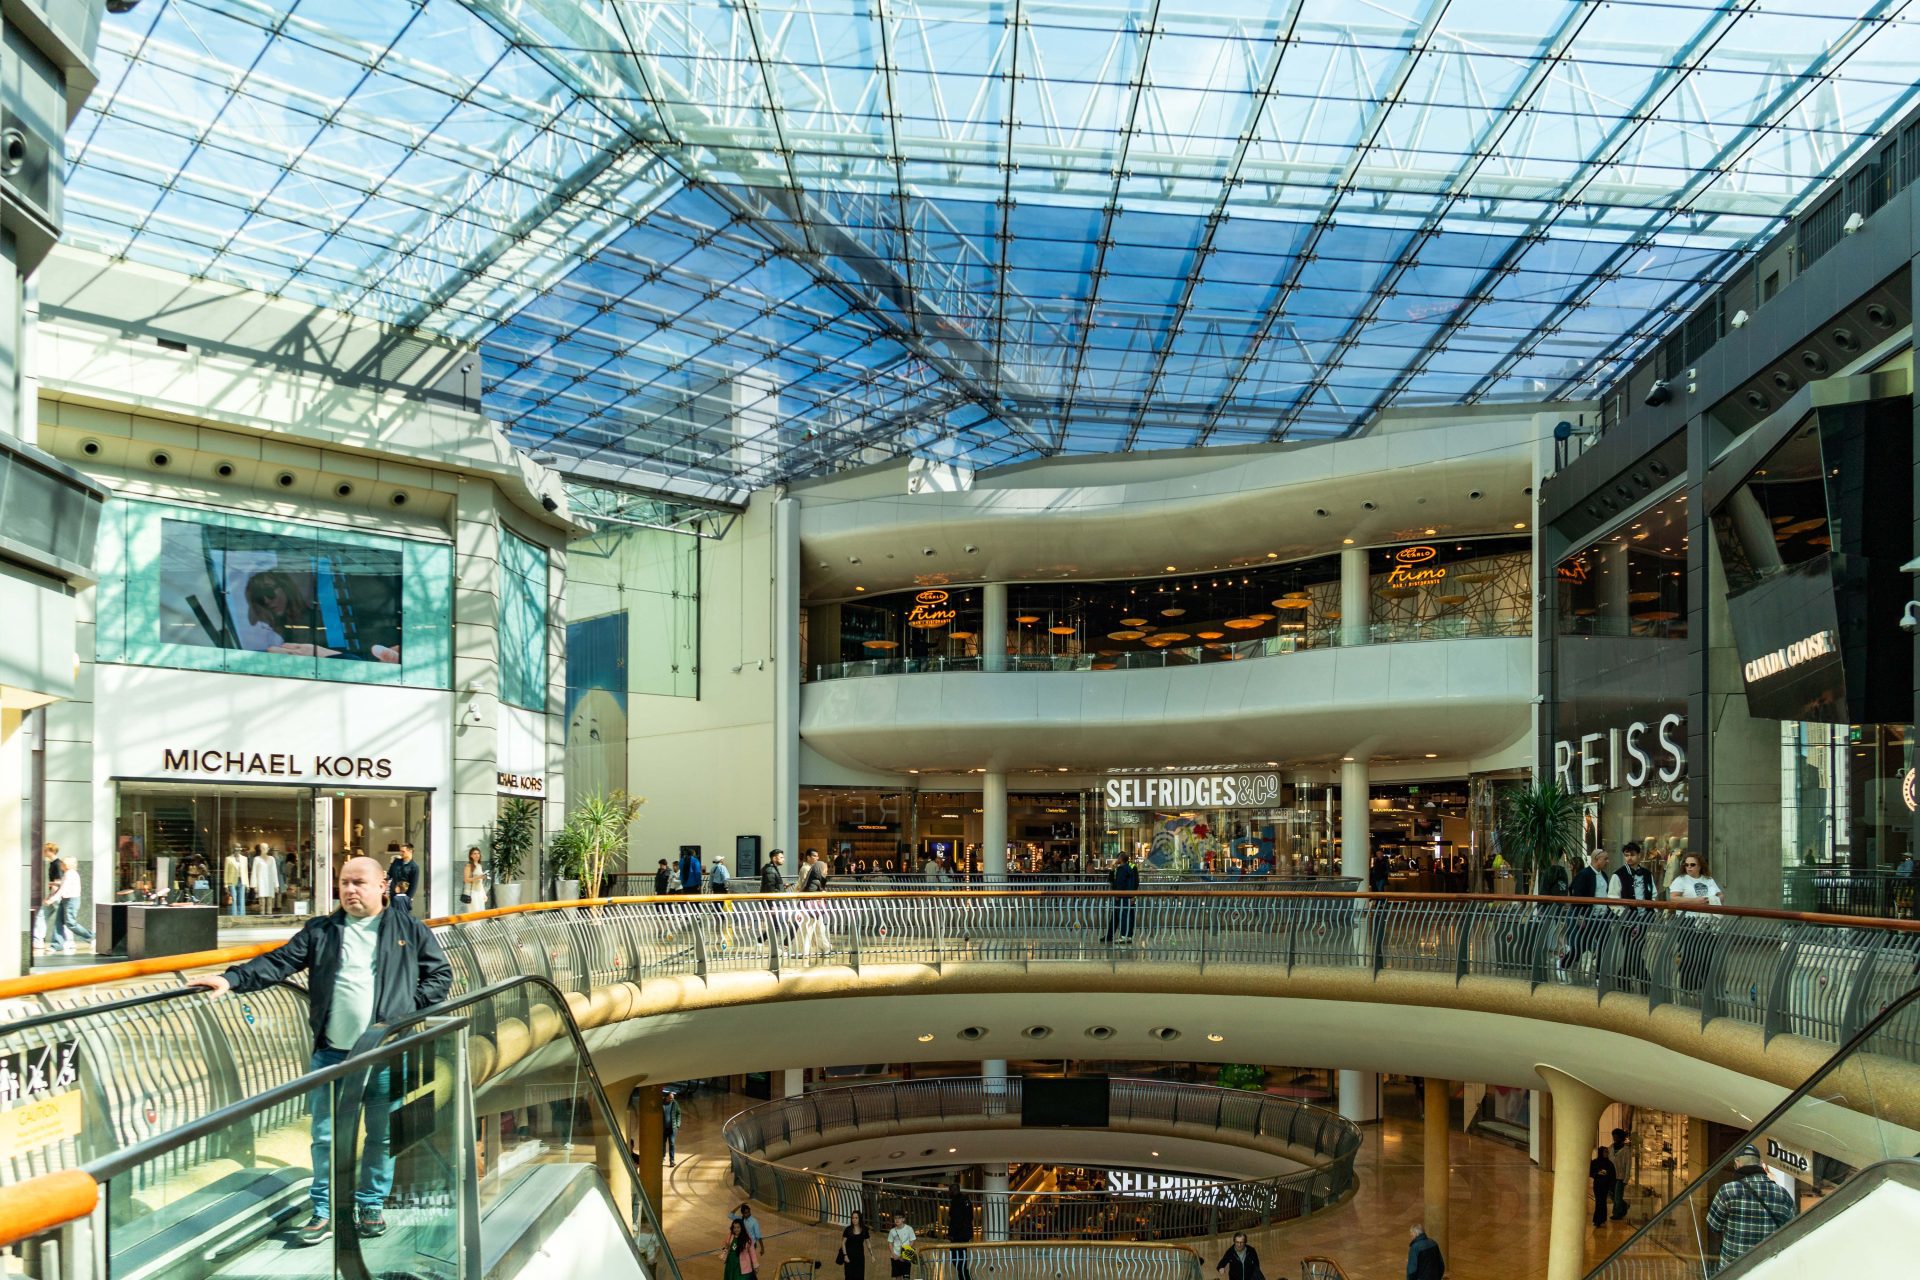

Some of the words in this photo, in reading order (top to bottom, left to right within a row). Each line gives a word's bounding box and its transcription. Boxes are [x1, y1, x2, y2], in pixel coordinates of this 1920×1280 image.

[1387, 564, 1446, 583] Fumo
[909, 605, 956, 620] Fumo
[1745, 648, 1790, 683] CANADA
[1787, 630, 1836, 667] GOOSE
[164, 749, 303, 775] MICHAEL
[315, 756, 393, 779] KORS
[1555, 713, 1688, 795] REISS
[520, 776, 543, 791] KORS
[1767, 1138, 1808, 1171] Dune
